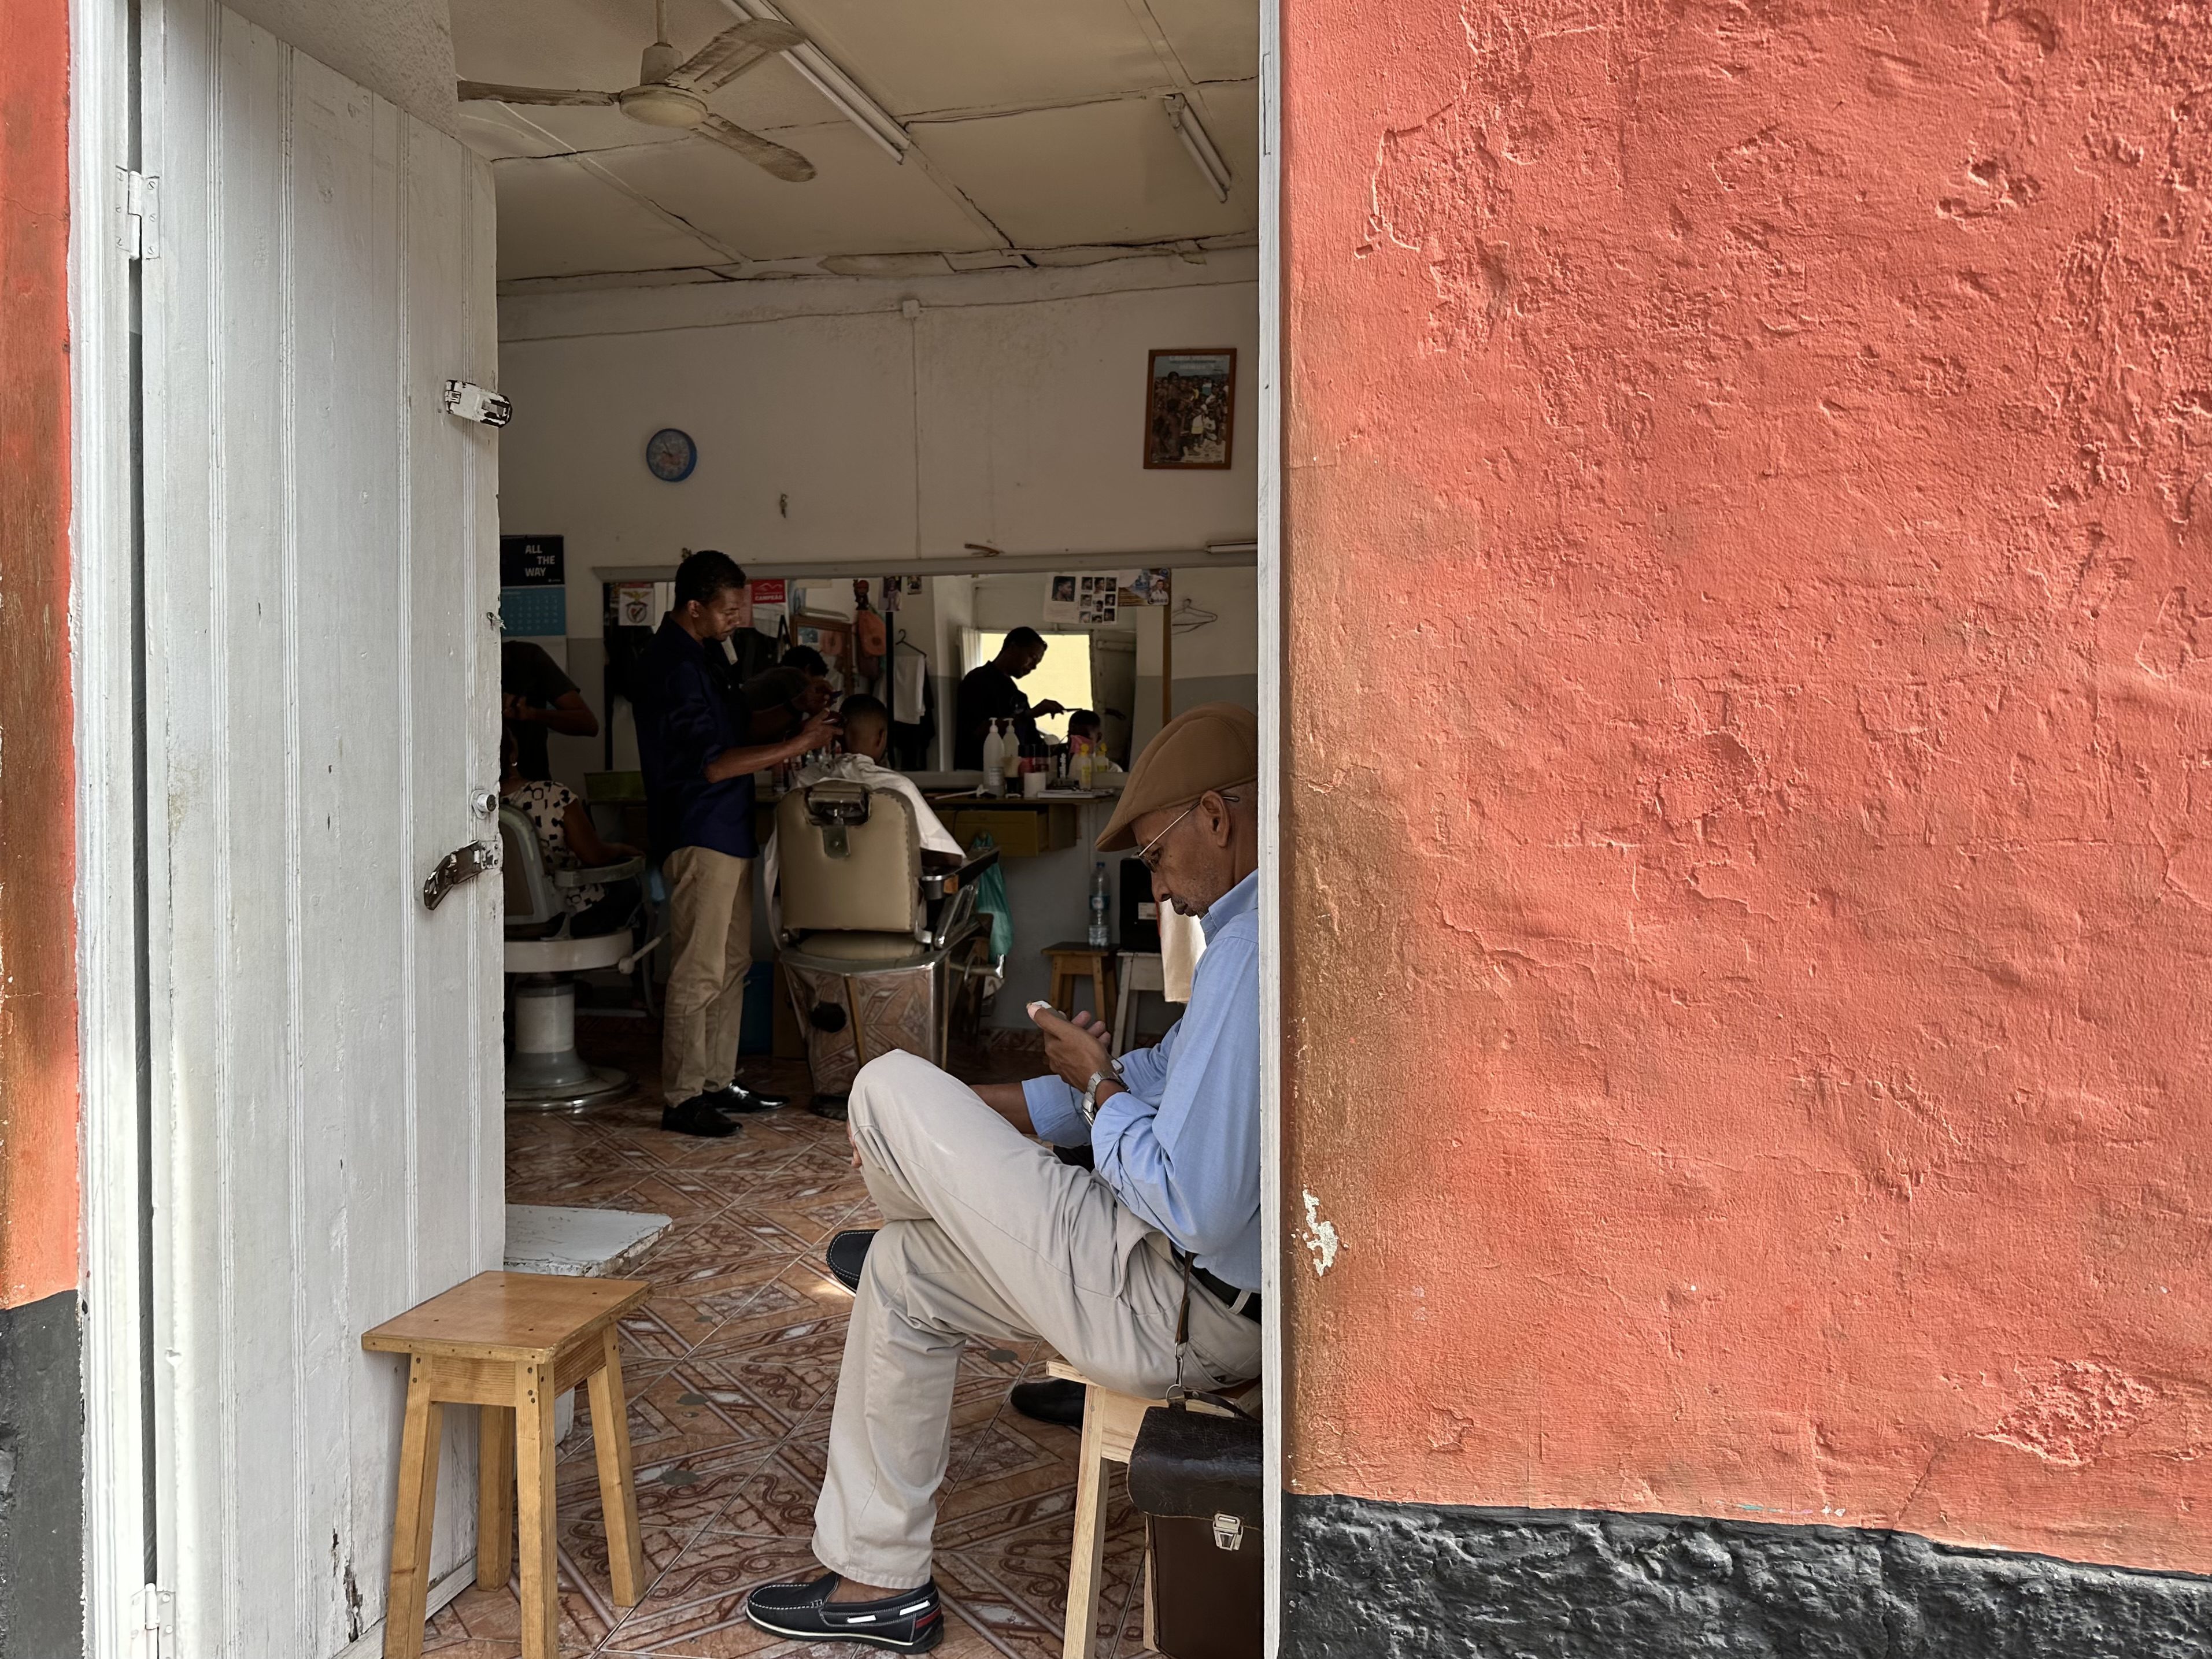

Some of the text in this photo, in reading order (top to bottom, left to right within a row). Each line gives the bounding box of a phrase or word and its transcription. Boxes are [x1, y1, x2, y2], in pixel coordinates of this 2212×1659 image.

[525, 545, 543, 554] ALL
[537, 555, 556, 565] THE
[525, 567, 546, 577] WAY
